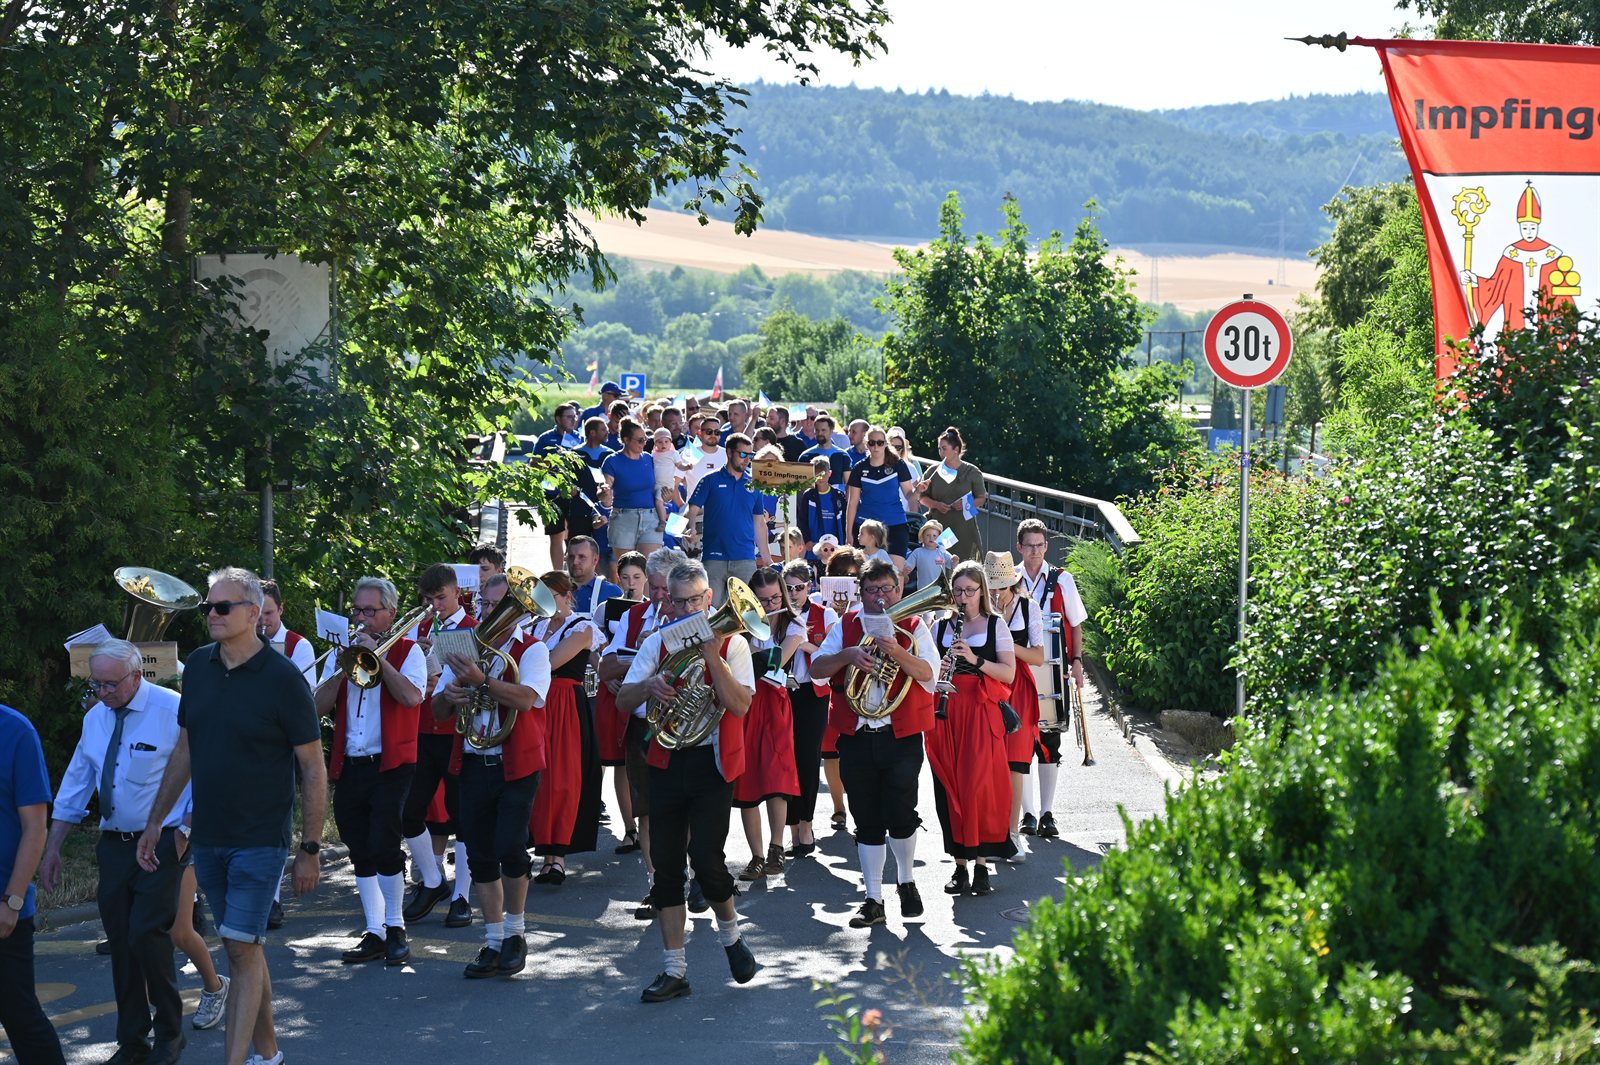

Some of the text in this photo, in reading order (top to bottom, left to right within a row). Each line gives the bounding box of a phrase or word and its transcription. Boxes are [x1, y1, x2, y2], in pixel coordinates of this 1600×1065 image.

[1414, 97, 1600, 140] Impfing
[1224, 325, 1272, 362] 30t
[626, 376, 640, 391] P
[774, 471, 807, 480] Impfingen
